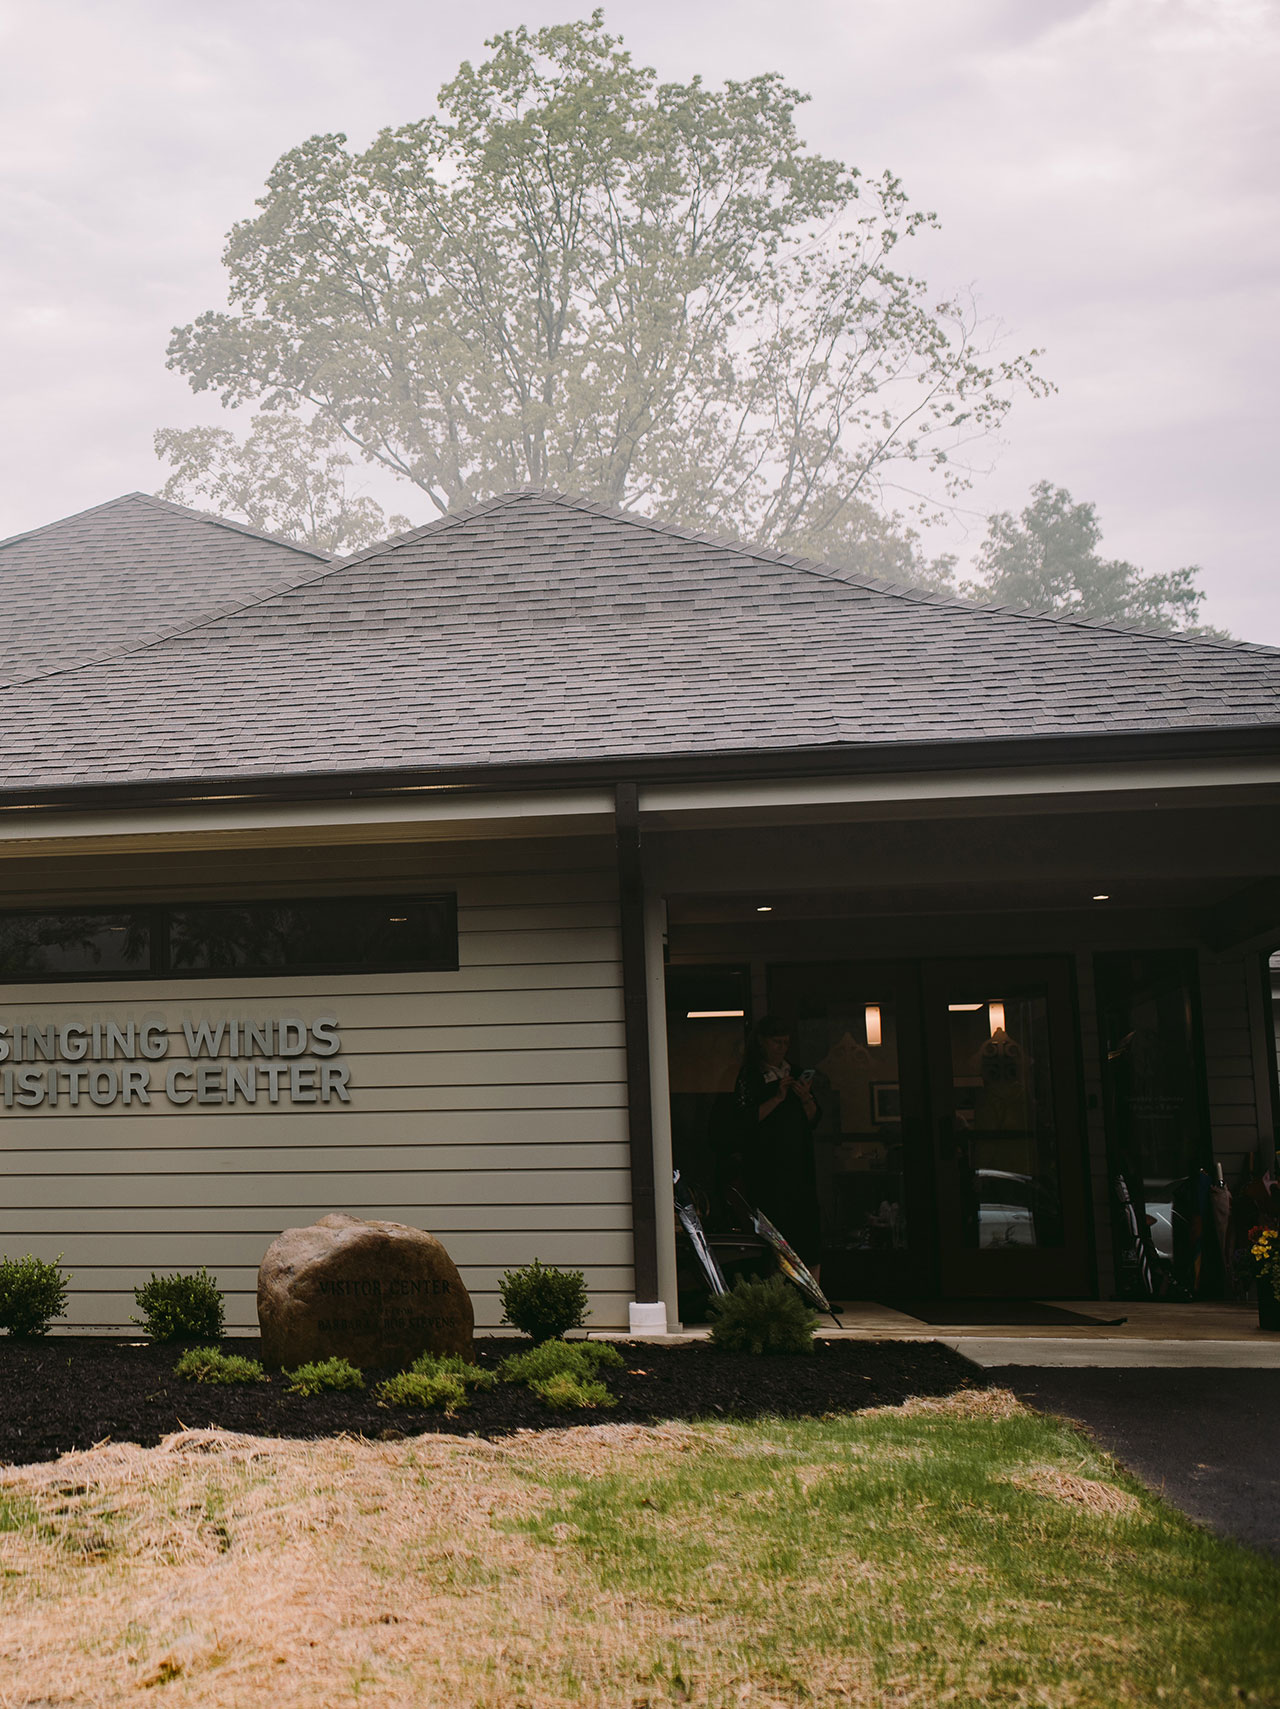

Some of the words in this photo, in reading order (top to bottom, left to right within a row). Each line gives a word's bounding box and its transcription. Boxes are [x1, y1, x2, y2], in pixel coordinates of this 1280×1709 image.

[182, 1017, 342, 1058] WINDS
[165, 1063, 352, 1105] CENTER
[319, 1280, 382, 1296] VISITOR
[390, 1279, 452, 1296] CENTER
